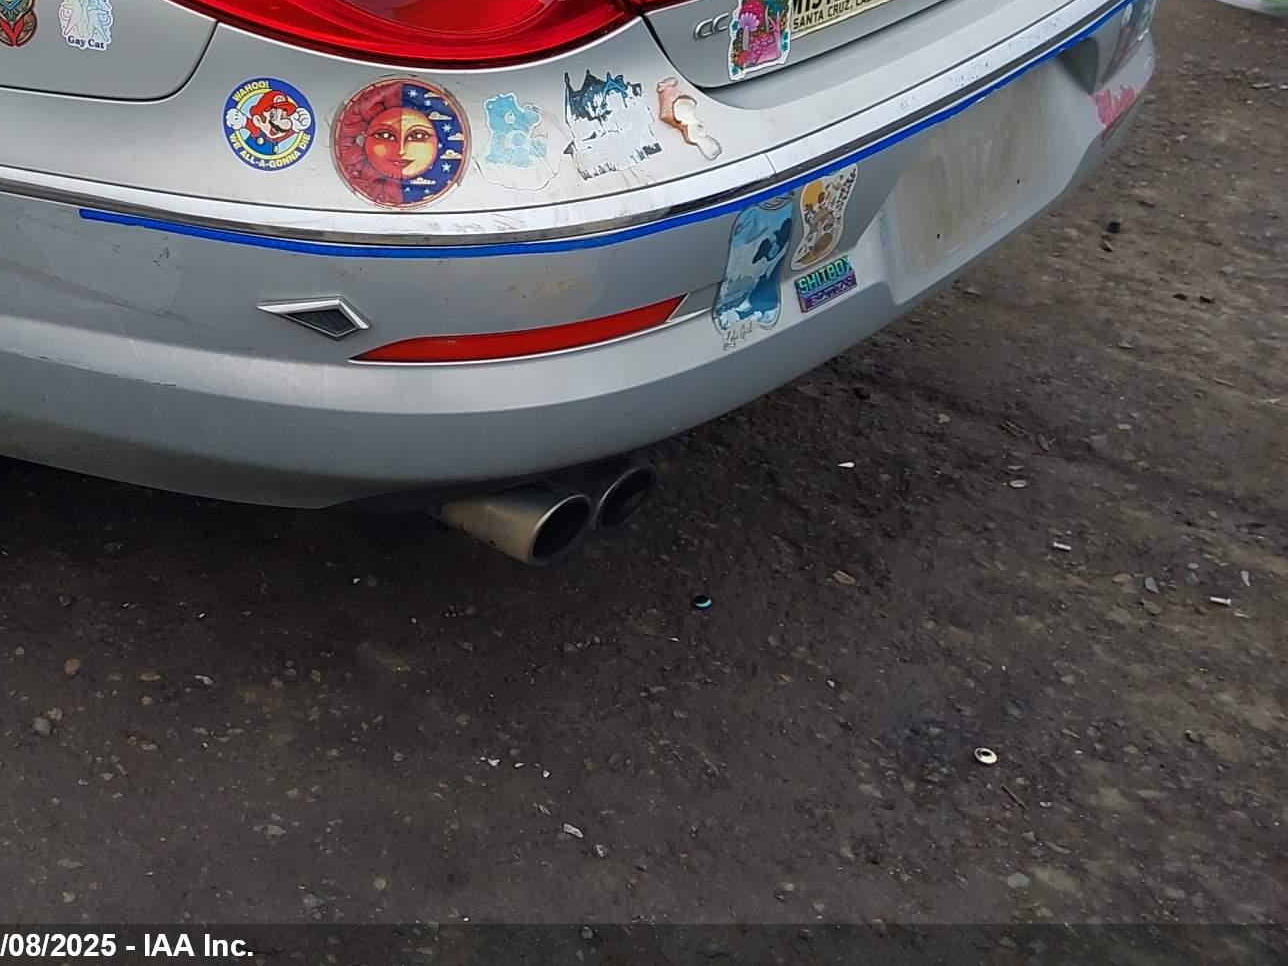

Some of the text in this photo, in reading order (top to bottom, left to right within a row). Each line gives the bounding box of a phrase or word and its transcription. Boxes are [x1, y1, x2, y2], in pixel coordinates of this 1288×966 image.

[793, 9, 824, 30] SANTA
[827, 0, 854, 18] CRUZ,
[67, 35, 105, 49] Gay Cat
[231, 80, 270, 102] WAHOO!
[229, 133, 312, 168] WE ALL-A-GONNA DIE
[797, 255, 854, 294] SHITBOX
